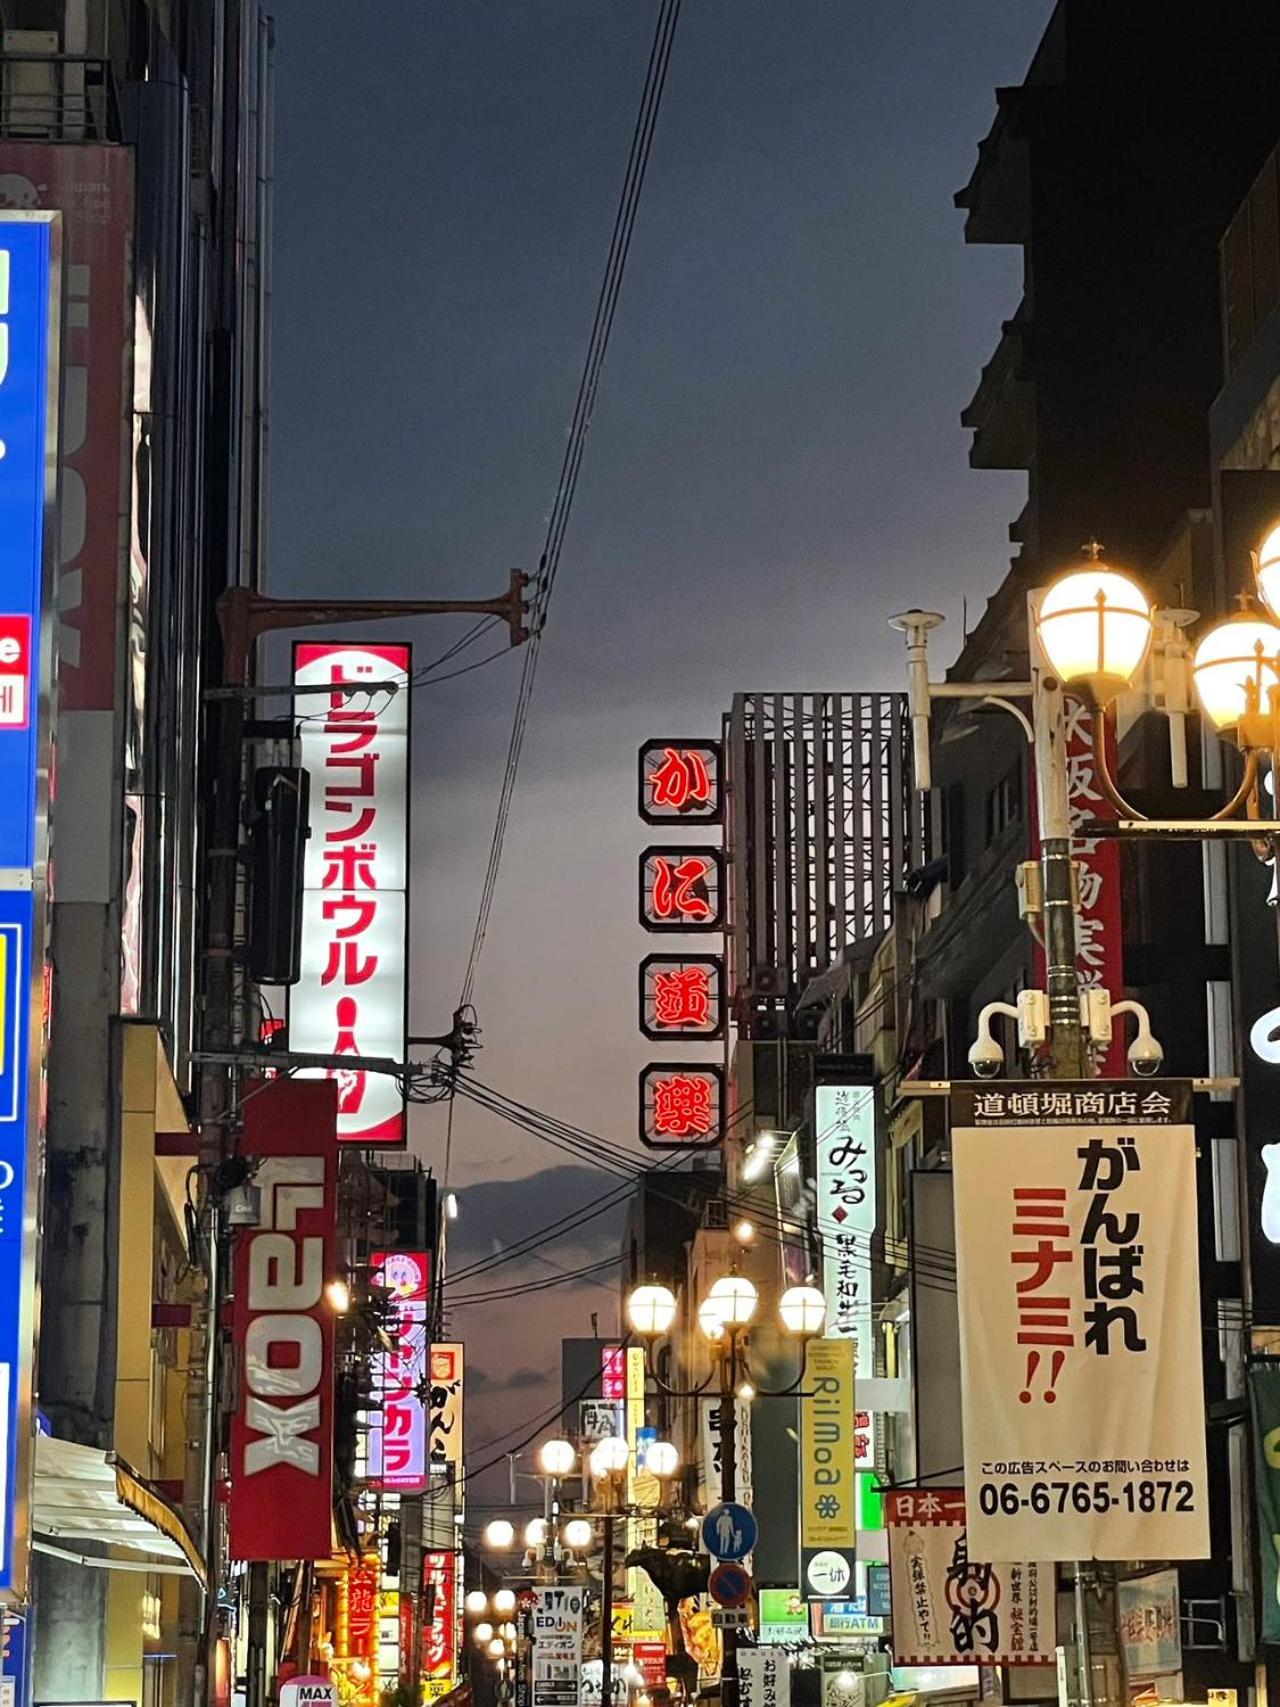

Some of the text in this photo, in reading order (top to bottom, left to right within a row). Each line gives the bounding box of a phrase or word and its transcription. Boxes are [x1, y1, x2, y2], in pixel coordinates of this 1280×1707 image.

[320, 664, 381, 986] ドラゴンボウル
[974, 1090, 1171, 1117] 道頓堀商店会
[1077, 1136, 1147, 1356] がんばれ
[1011, 1187, 1075, 1405] ミナミ!!
[981, 1460, 1190, 1475] この広告スペースのお問い合わせは
[979, 1480, 1194, 1515] 06-6765-1872
[536, 1616, 578, 1632] EDION
[299, 1687, 333, 1700] MAX
